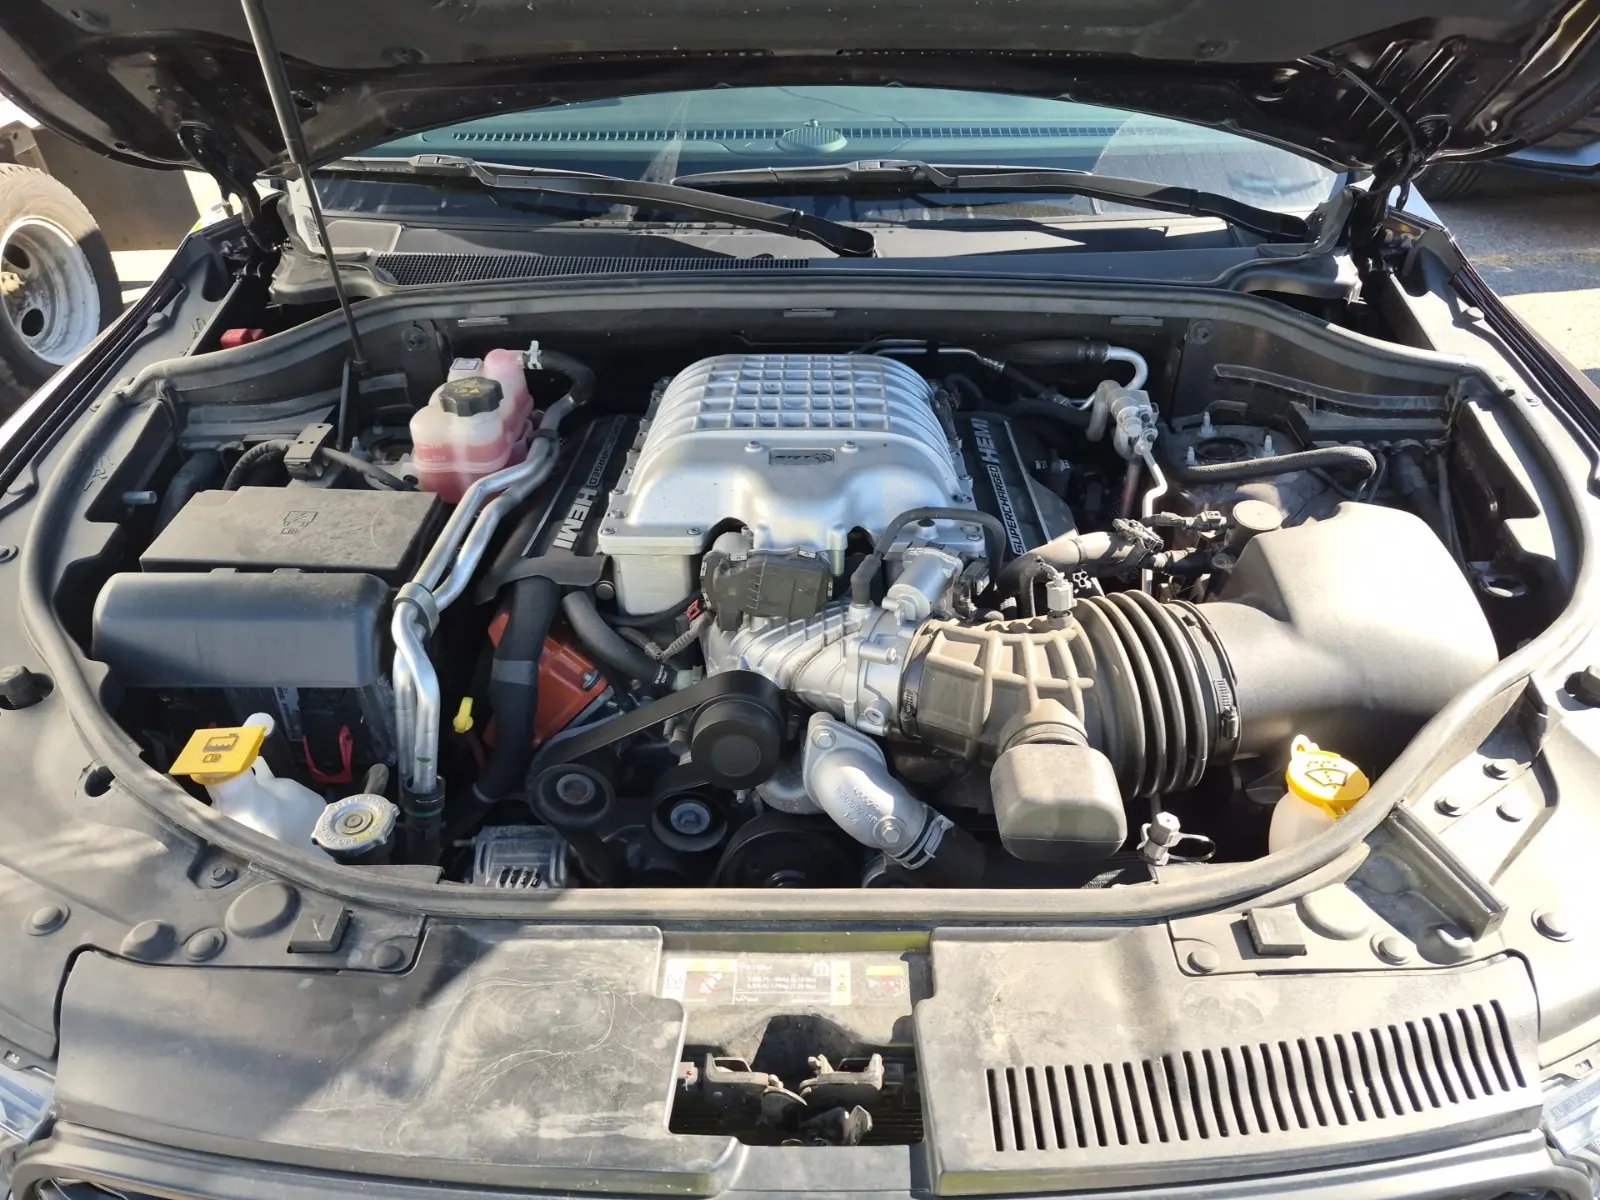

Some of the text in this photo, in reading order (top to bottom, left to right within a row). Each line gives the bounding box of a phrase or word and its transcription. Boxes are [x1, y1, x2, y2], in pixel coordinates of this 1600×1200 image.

[553, 487, 599, 550] HEMI
[971, 417, 1026, 556] SUPERCHARGED HEMI
